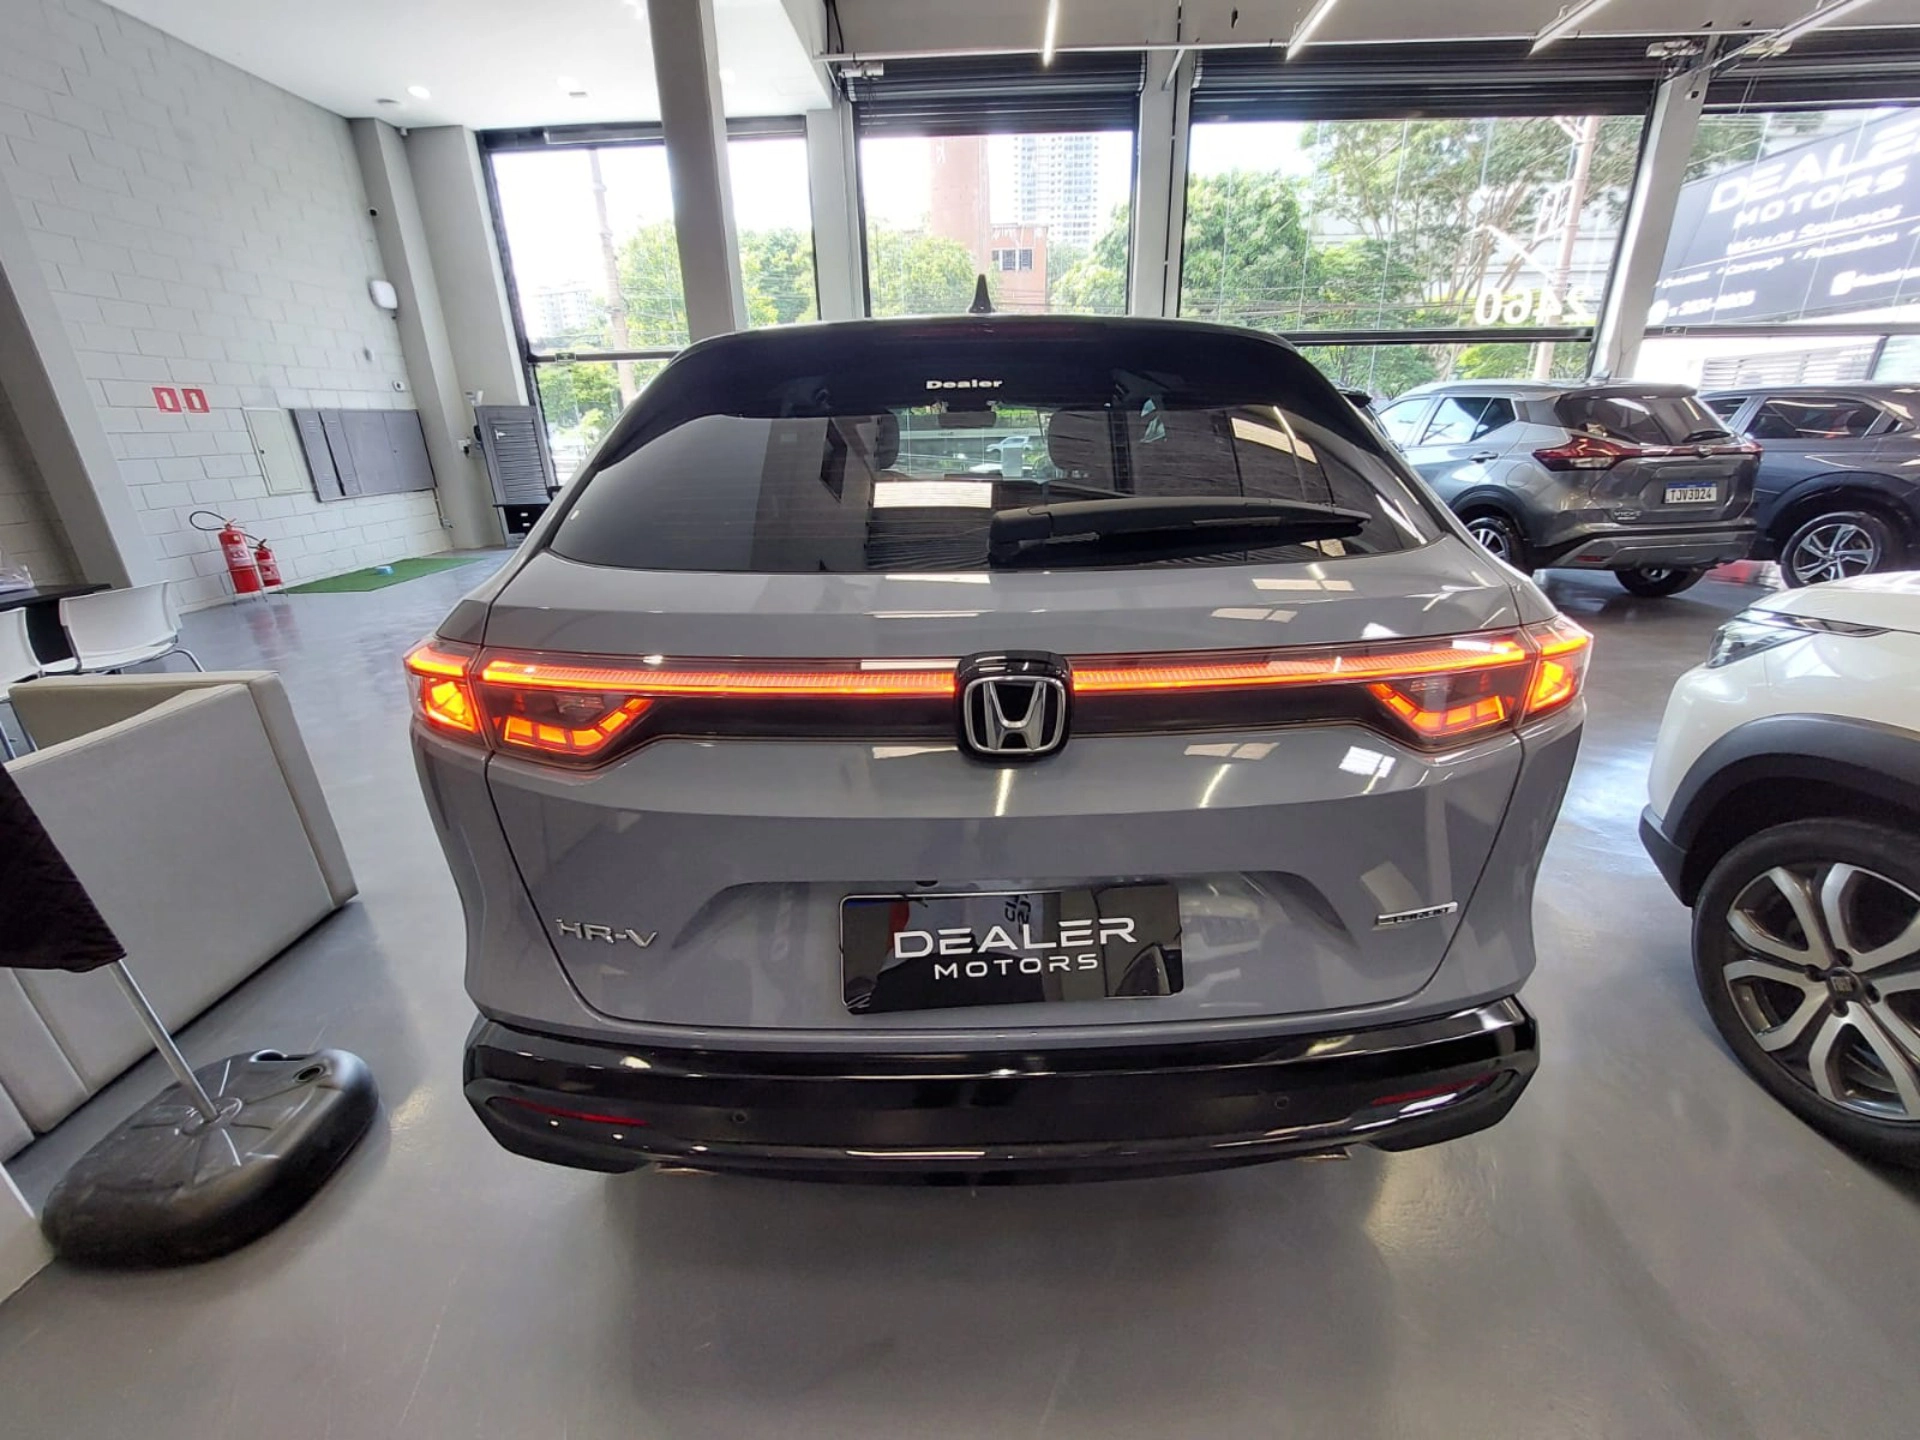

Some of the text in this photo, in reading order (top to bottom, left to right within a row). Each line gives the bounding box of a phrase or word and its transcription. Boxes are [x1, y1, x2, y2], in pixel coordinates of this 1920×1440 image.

[1709, 119, 1920, 214] DEALE
[1733, 164, 1909, 230] MOTORS
[926, 379, 1002, 389] Dealer
[556, 918, 658, 947] HR-V
[894, 917, 1138, 959] DEALER
[934, 953, 1099, 980] MOTORS
